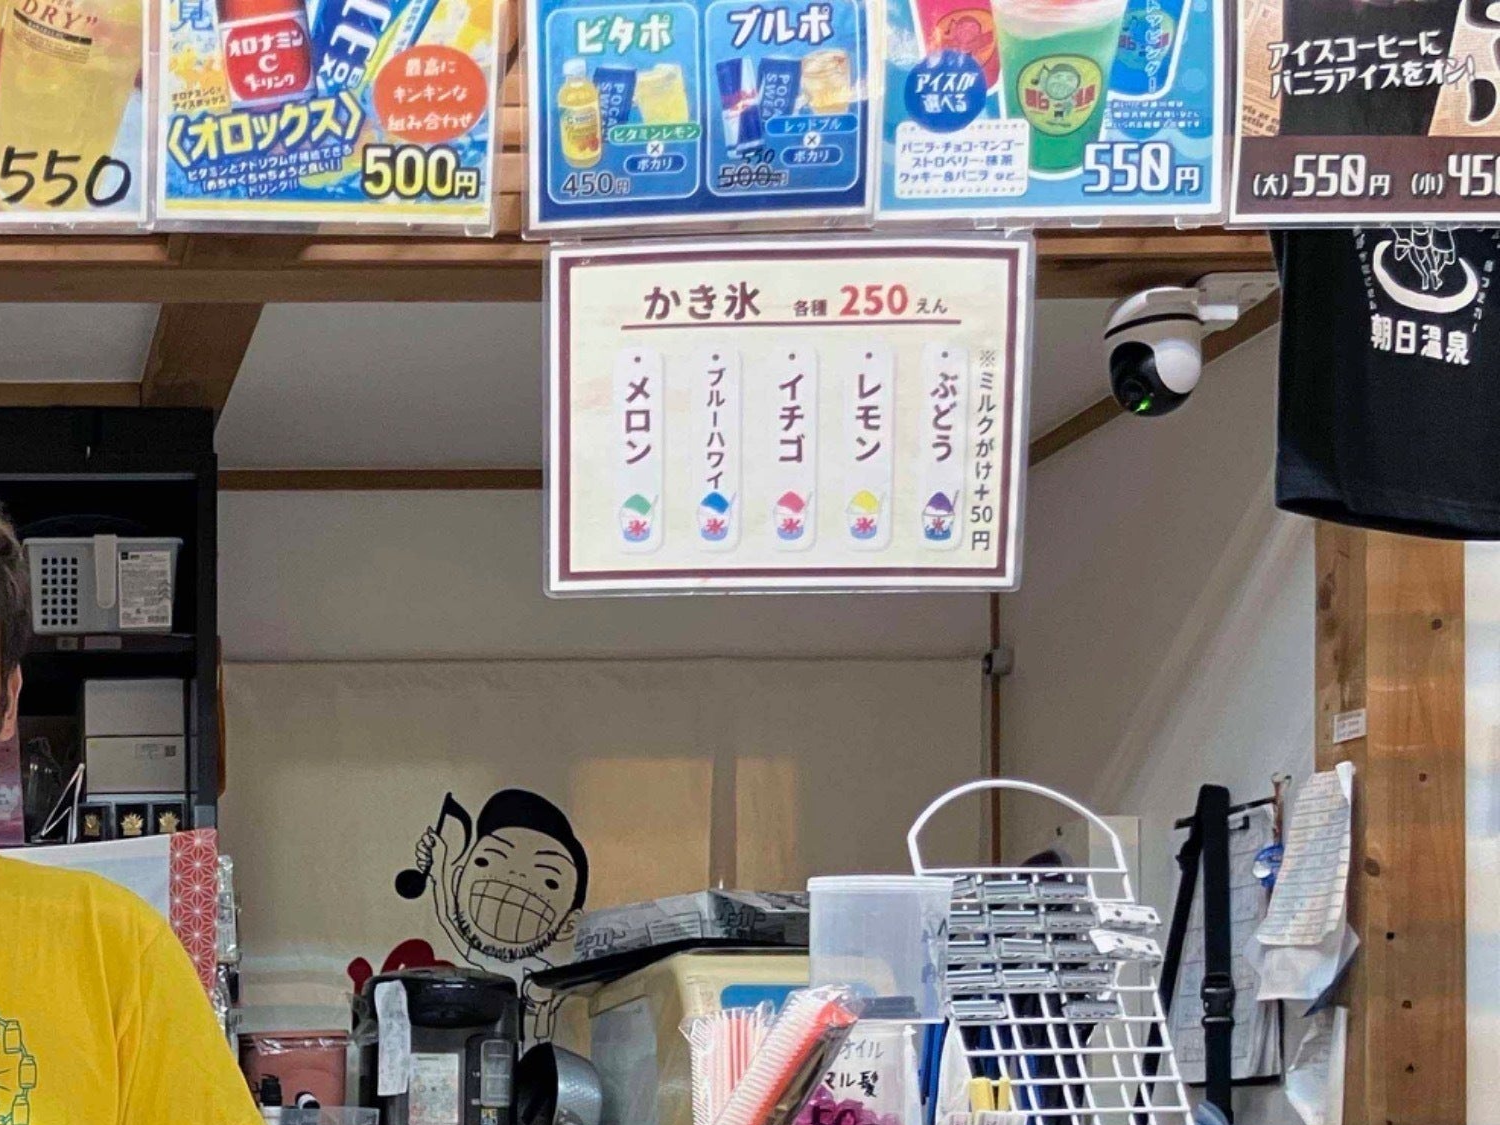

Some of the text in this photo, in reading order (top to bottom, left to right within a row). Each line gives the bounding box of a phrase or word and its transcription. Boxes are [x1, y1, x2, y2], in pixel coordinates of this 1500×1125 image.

[576, 14, 673, 55] ビタポ
[729, 3, 834, 49] ブルポ
[228, 31, 303, 58] オロナミン
[1268, 29, 1442, 68] アイスコーヒーに
[258, 54, 278, 73] C
[404, 57, 456, 78] 最高に
[243, 74, 296, 92] ドリンク
[392, 85, 469, 104] キンキンな
[915, 72, 977, 94] アイスが
[922, 94, 968, 115] 選べる
[386, 112, 474, 132] 組み合わせ
[612, 126, 698, 141] ビタミンレモン
[783, 118, 843, 132] レッドブル
[364, 146, 479, 198] 500円
[636, 158, 675, 171] ポカリ
[792, 150, 830, 163] ポカリ
[1084, 142, 1200, 194] 550円
[562, 173, 630, 197] 450円
[1411, 154, 1500, 197] (小)45
[644, 281, 949, 321] かき氷 各種 250 えん
[1370, 313, 1471, 366] 朝日温泉
[624, 375, 653, 466] メロン
[705, 366, 726, 490] ブルーハワイ
[777, 372, 806, 464] イチゴ
[855, 371, 882, 462] レモン
[929, 371, 958, 462] ぶどう
